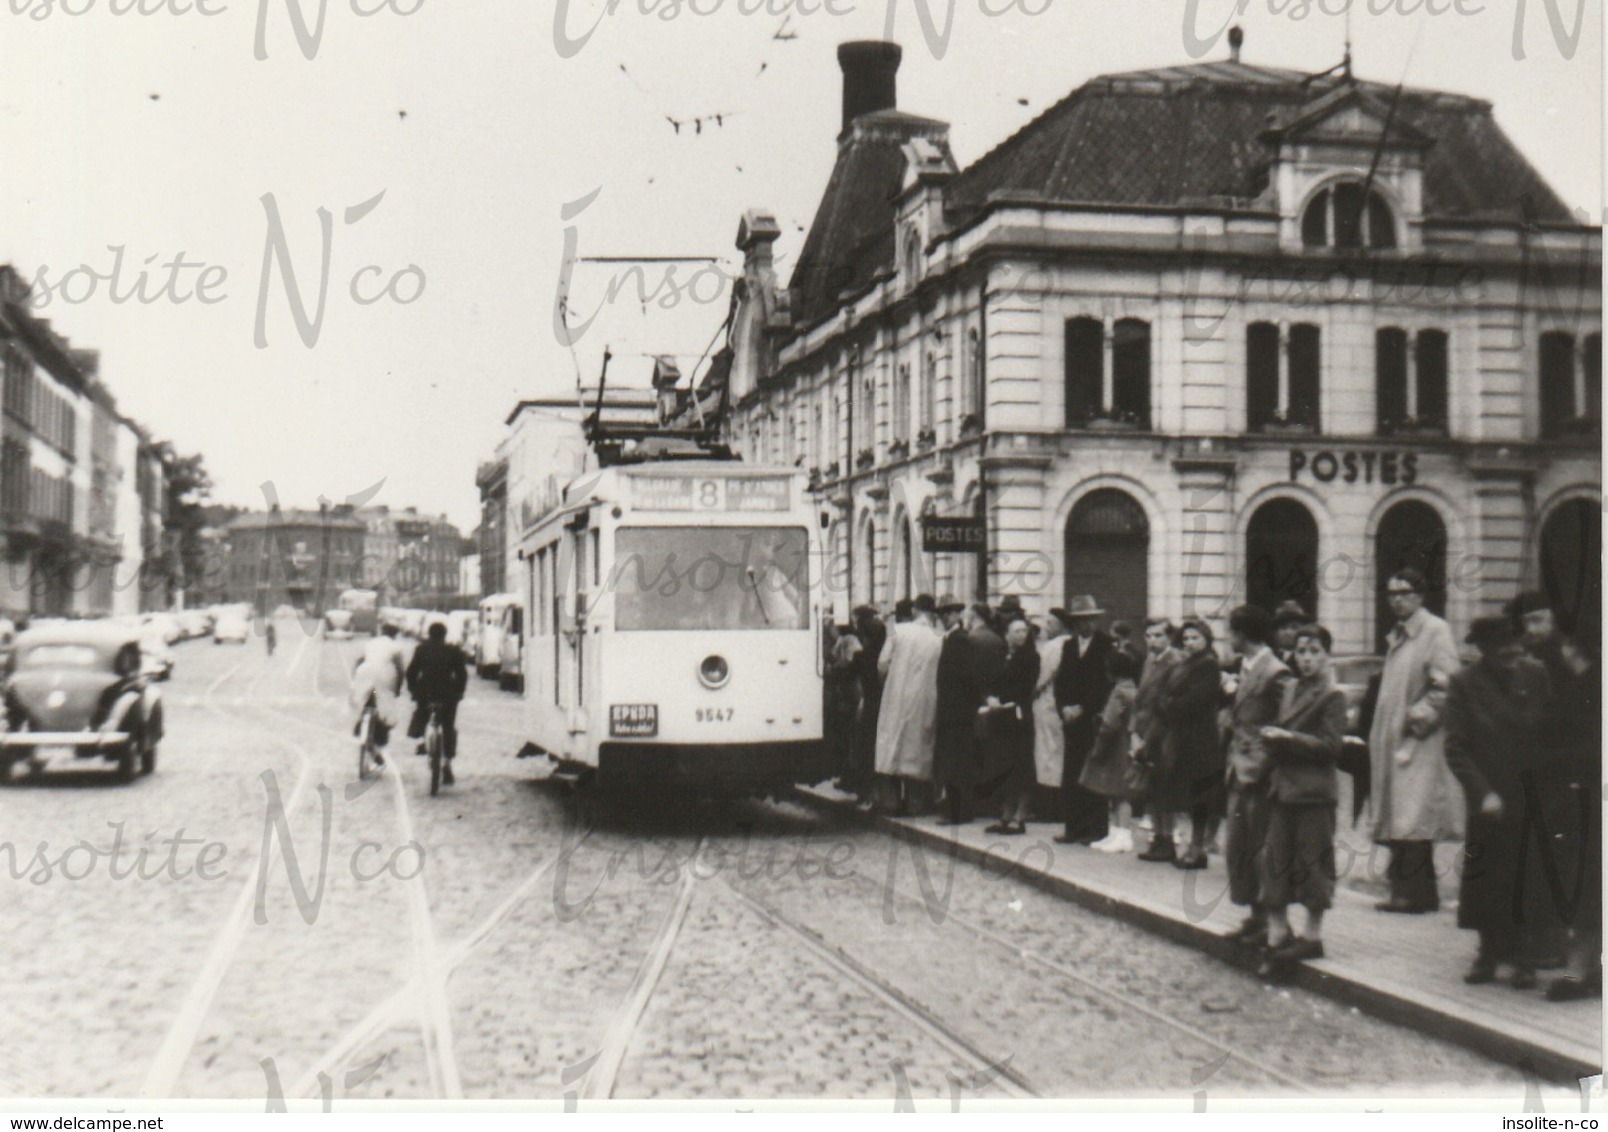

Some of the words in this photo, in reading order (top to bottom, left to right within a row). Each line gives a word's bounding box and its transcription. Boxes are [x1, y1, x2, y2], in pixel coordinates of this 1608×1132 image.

[1290, 450, 1418, 484] POSTES
[700, 480, 718, 508] 8
[926, 525, 984, 543] POSTES
[695, 708, 734, 722] 9547
